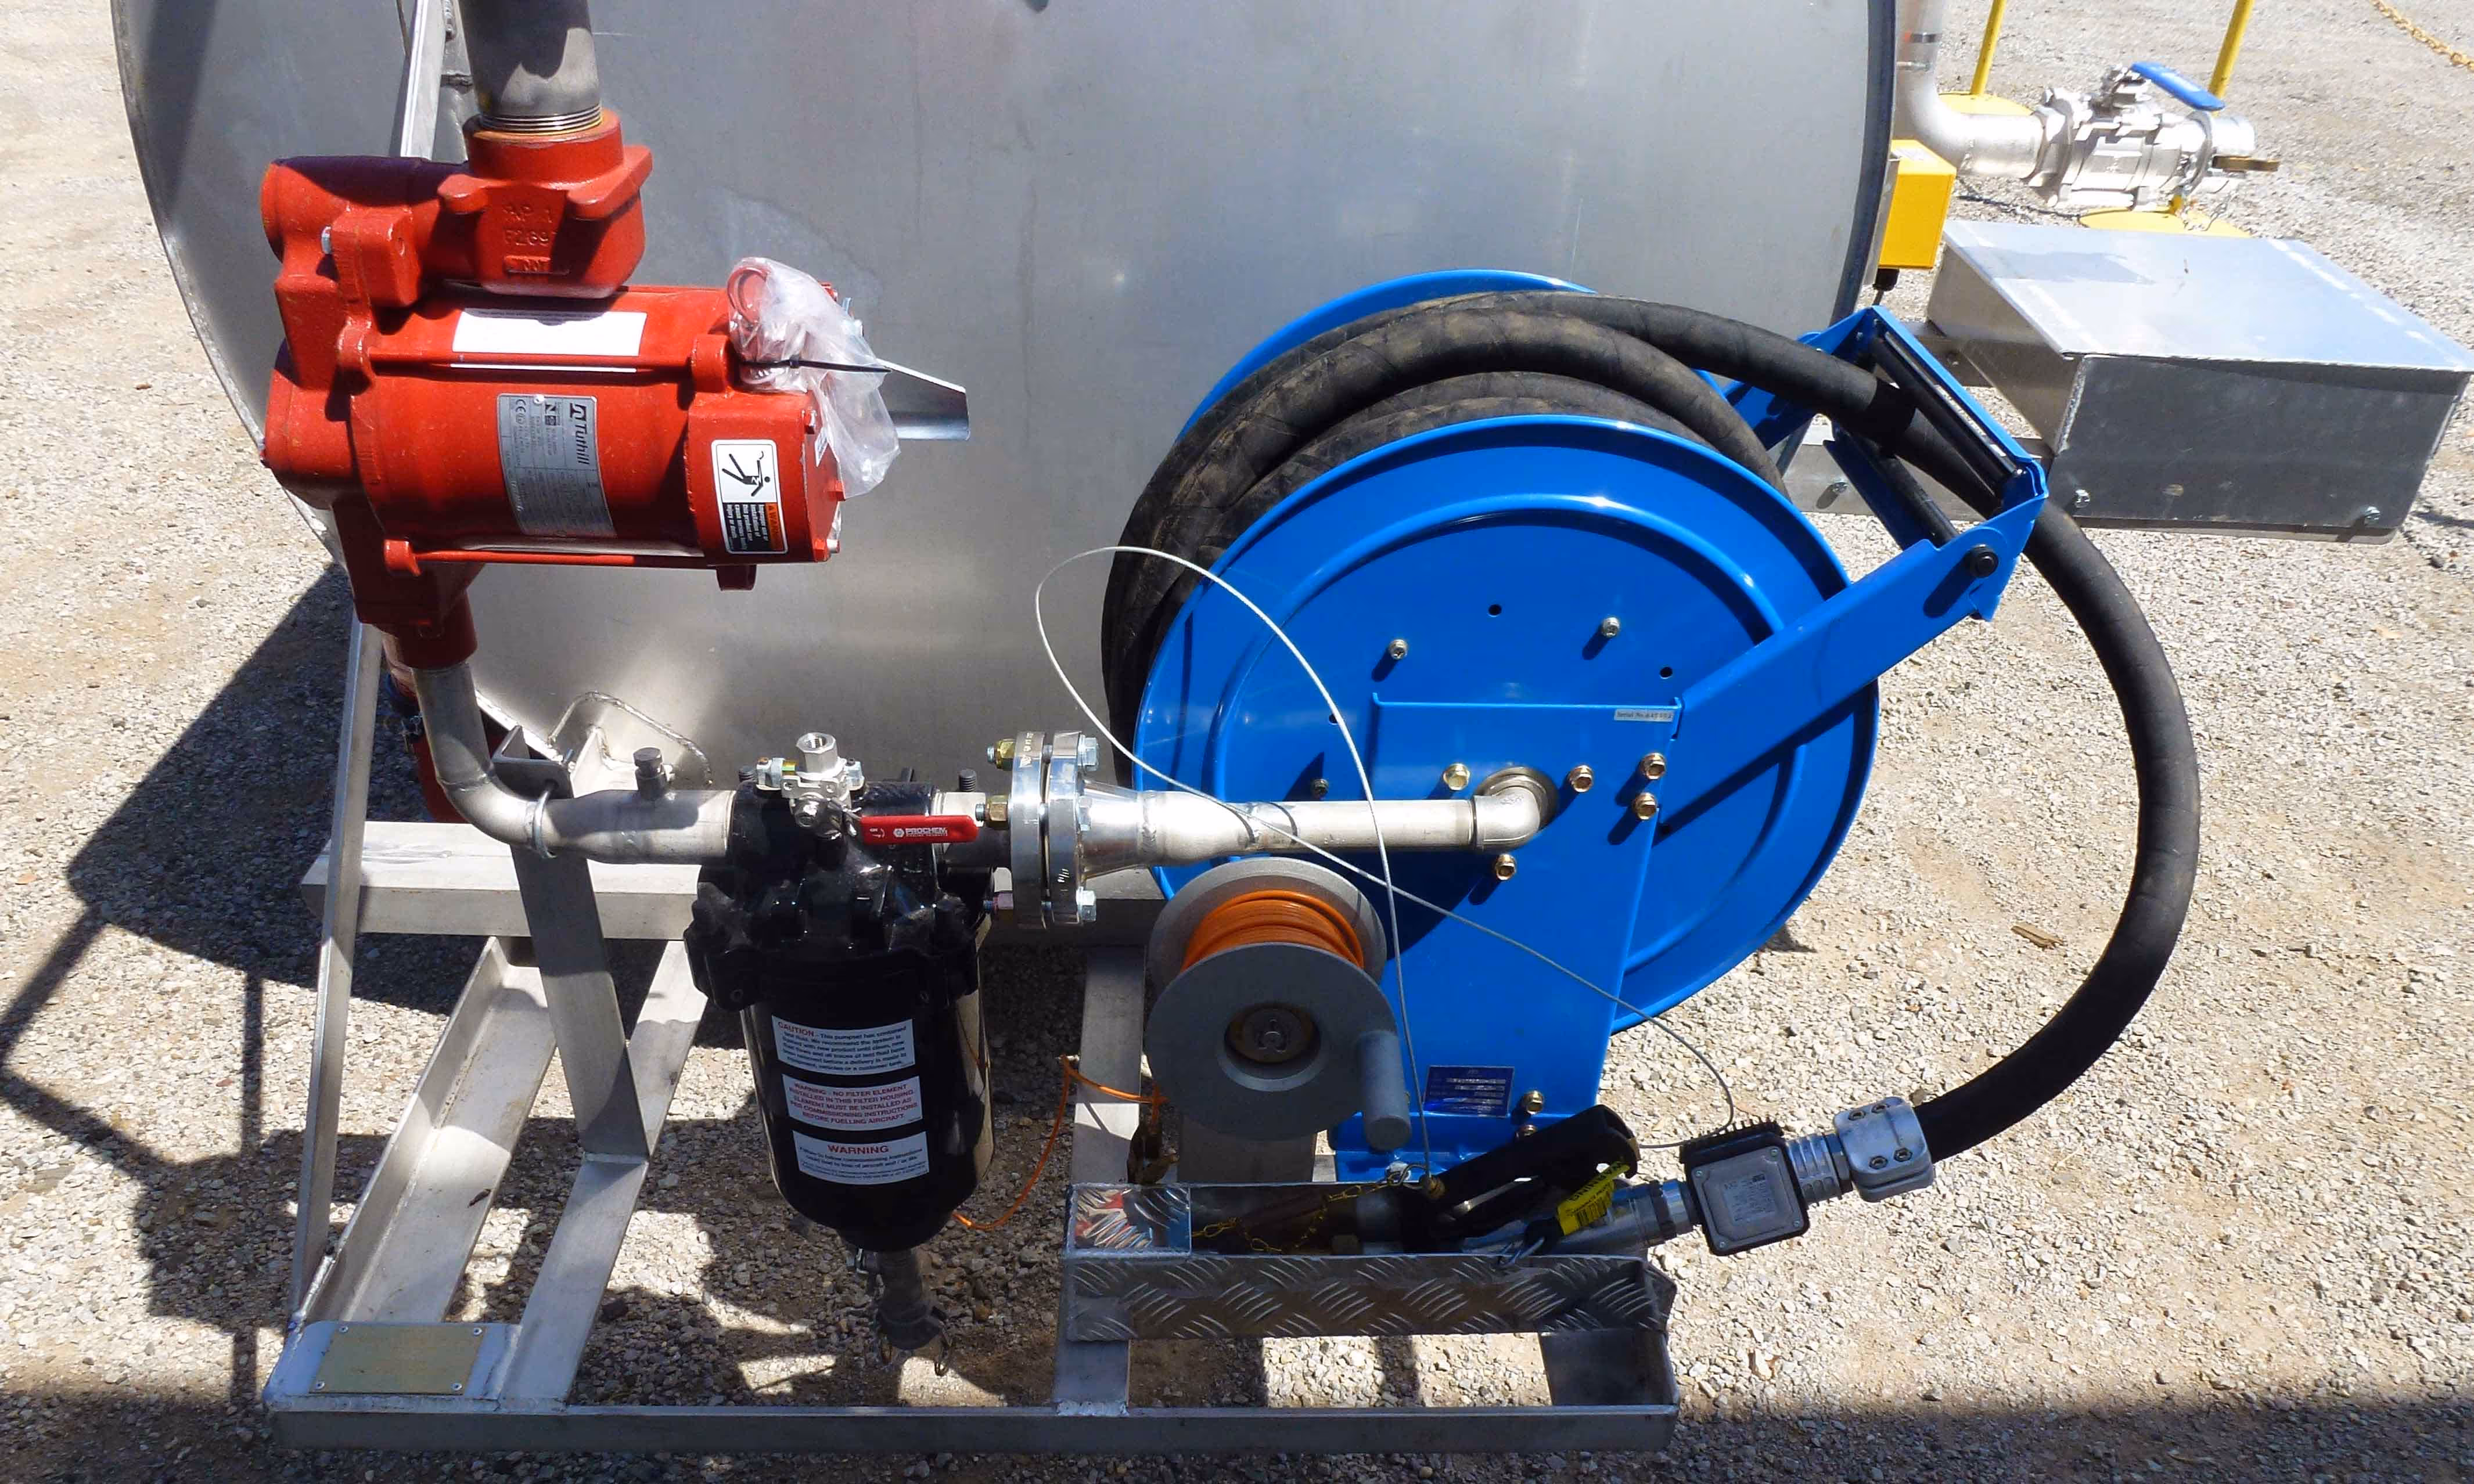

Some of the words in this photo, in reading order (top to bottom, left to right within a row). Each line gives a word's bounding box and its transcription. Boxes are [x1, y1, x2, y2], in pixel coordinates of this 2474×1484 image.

[573, 423, 590, 465] Tuthill
[743, 514, 752, 532] product
[750, 504, 760, 531] installation
[778, 1021, 814, 1036] CAUTION
[794, 1082, 826, 1094] WARNING
[873, 1085, 907, 1095] ELEMENT
[794, 1096, 825, 1107] ELEMENT
[861, 1100, 901, 1110] INSTALLED
[865, 1103, 918, 1116] INSTRUCTIONS
[827, 1144, 889, 1155] WARNING
